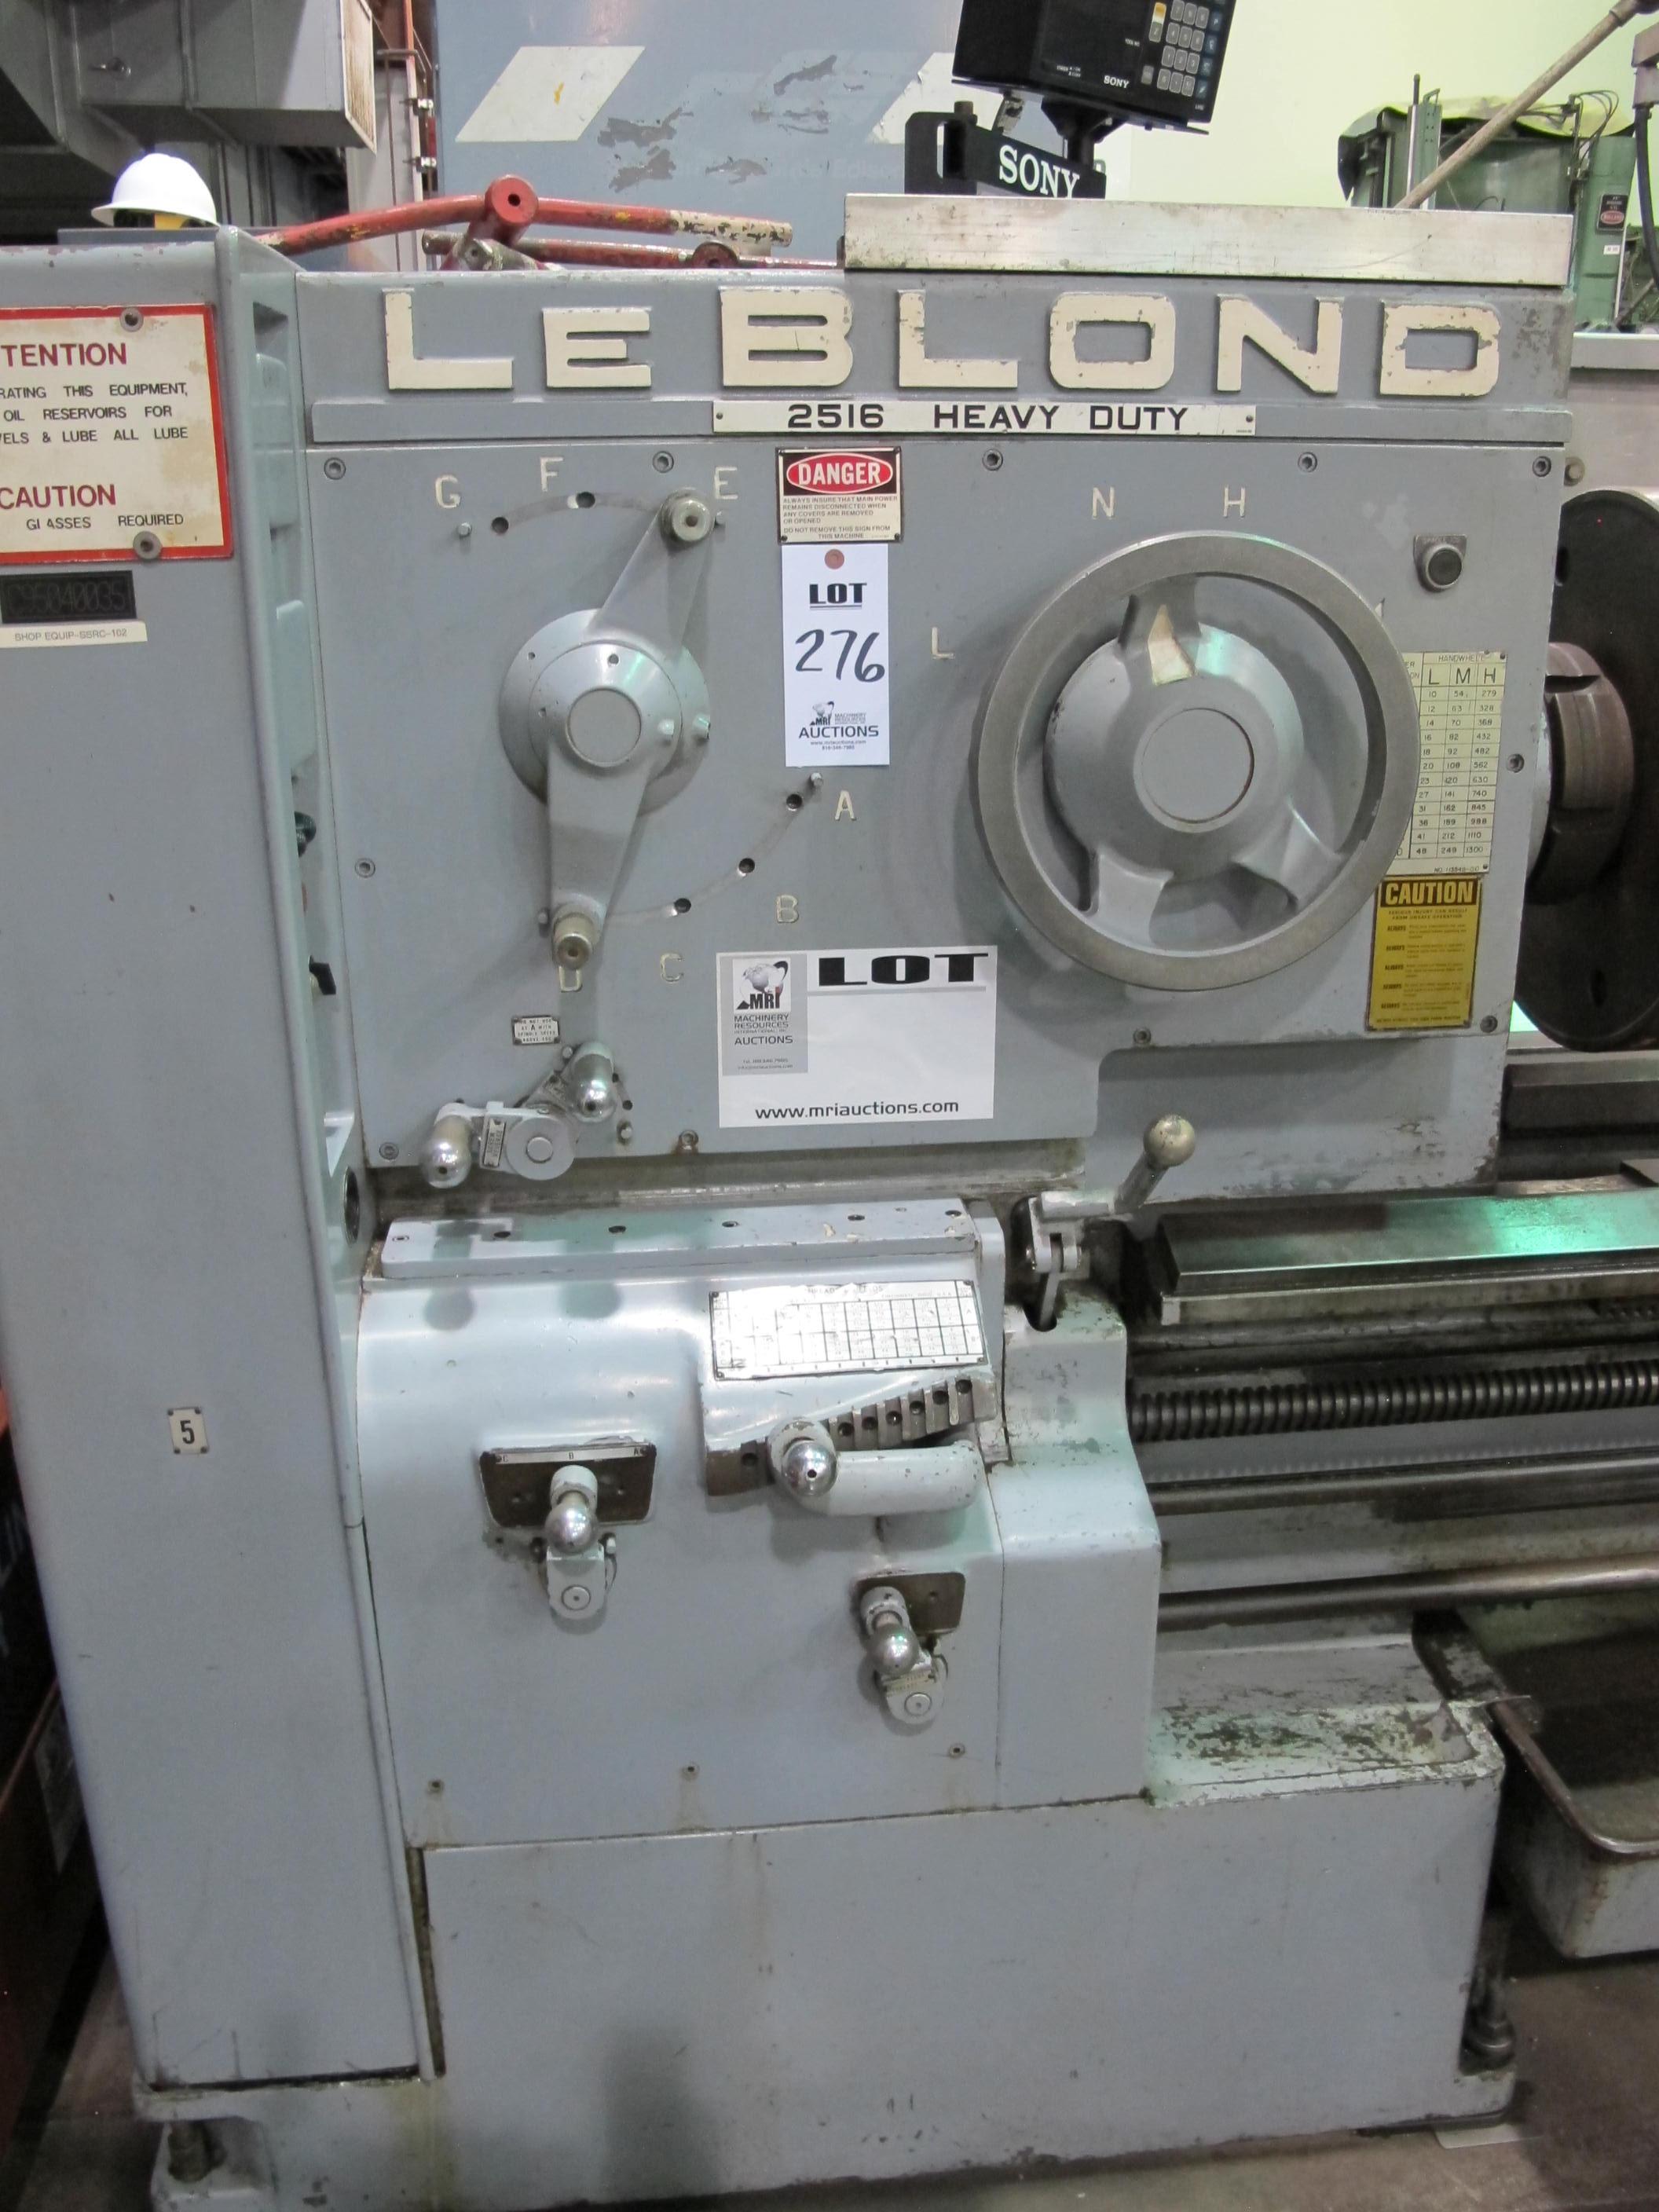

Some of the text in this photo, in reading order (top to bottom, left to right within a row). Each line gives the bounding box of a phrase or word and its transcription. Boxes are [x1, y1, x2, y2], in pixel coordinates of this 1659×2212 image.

[1104, 75, 1130, 89] SONY
[999, 145, 1080, 198] SONY
[383, 287, 1501, 397] LEBLOND
[1, 342, 127, 367] TENTION
[63, 385, 93, 397] THIS
[109, 383, 188, 397] EQUIPMENT,
[3, 405, 172, 422] OIL RESERVOIRS FOR
[787, 404, 1188, 431] 2516 HEAVY DUTY
[0, 427, 189, 445] ELS & LUBE ALL LUBE
[540, 456, 564, 492] F
[798, 462, 881, 485] DANGER
[0, 484, 116, 510] CAUTION
[434, 466, 738, 509] G E
[1091, 486, 1247, 519] N H
[26, 514, 184, 530] GLASSES REQUIRED
[809, 583, 867, 604] LOT
[15, 632, 42, 642] SHOP
[931, 627, 954, 659] L
[795, 628, 885, 683] 276
[1428, 668, 1496, 685] L M H
[799, 725, 879, 739] AUCTIONS
[834, 790, 857, 821] A
[1386, 881, 1474, 905] CAUTION
[775, 895, 800, 924] B
[660, 953, 684, 982] C
[819, 952, 989, 987] LOT
[749, 987, 780, 1009] MRI
[734, 1013, 789, 1023] MACHINERY
[734, 1021, 789, 1030] RESOURCES
[734, 1035, 793, 1046] AUCTIONS
[755, 1101, 959, 1119] www.mriauctions.com
[180, 1419, 195, 1445] 5
